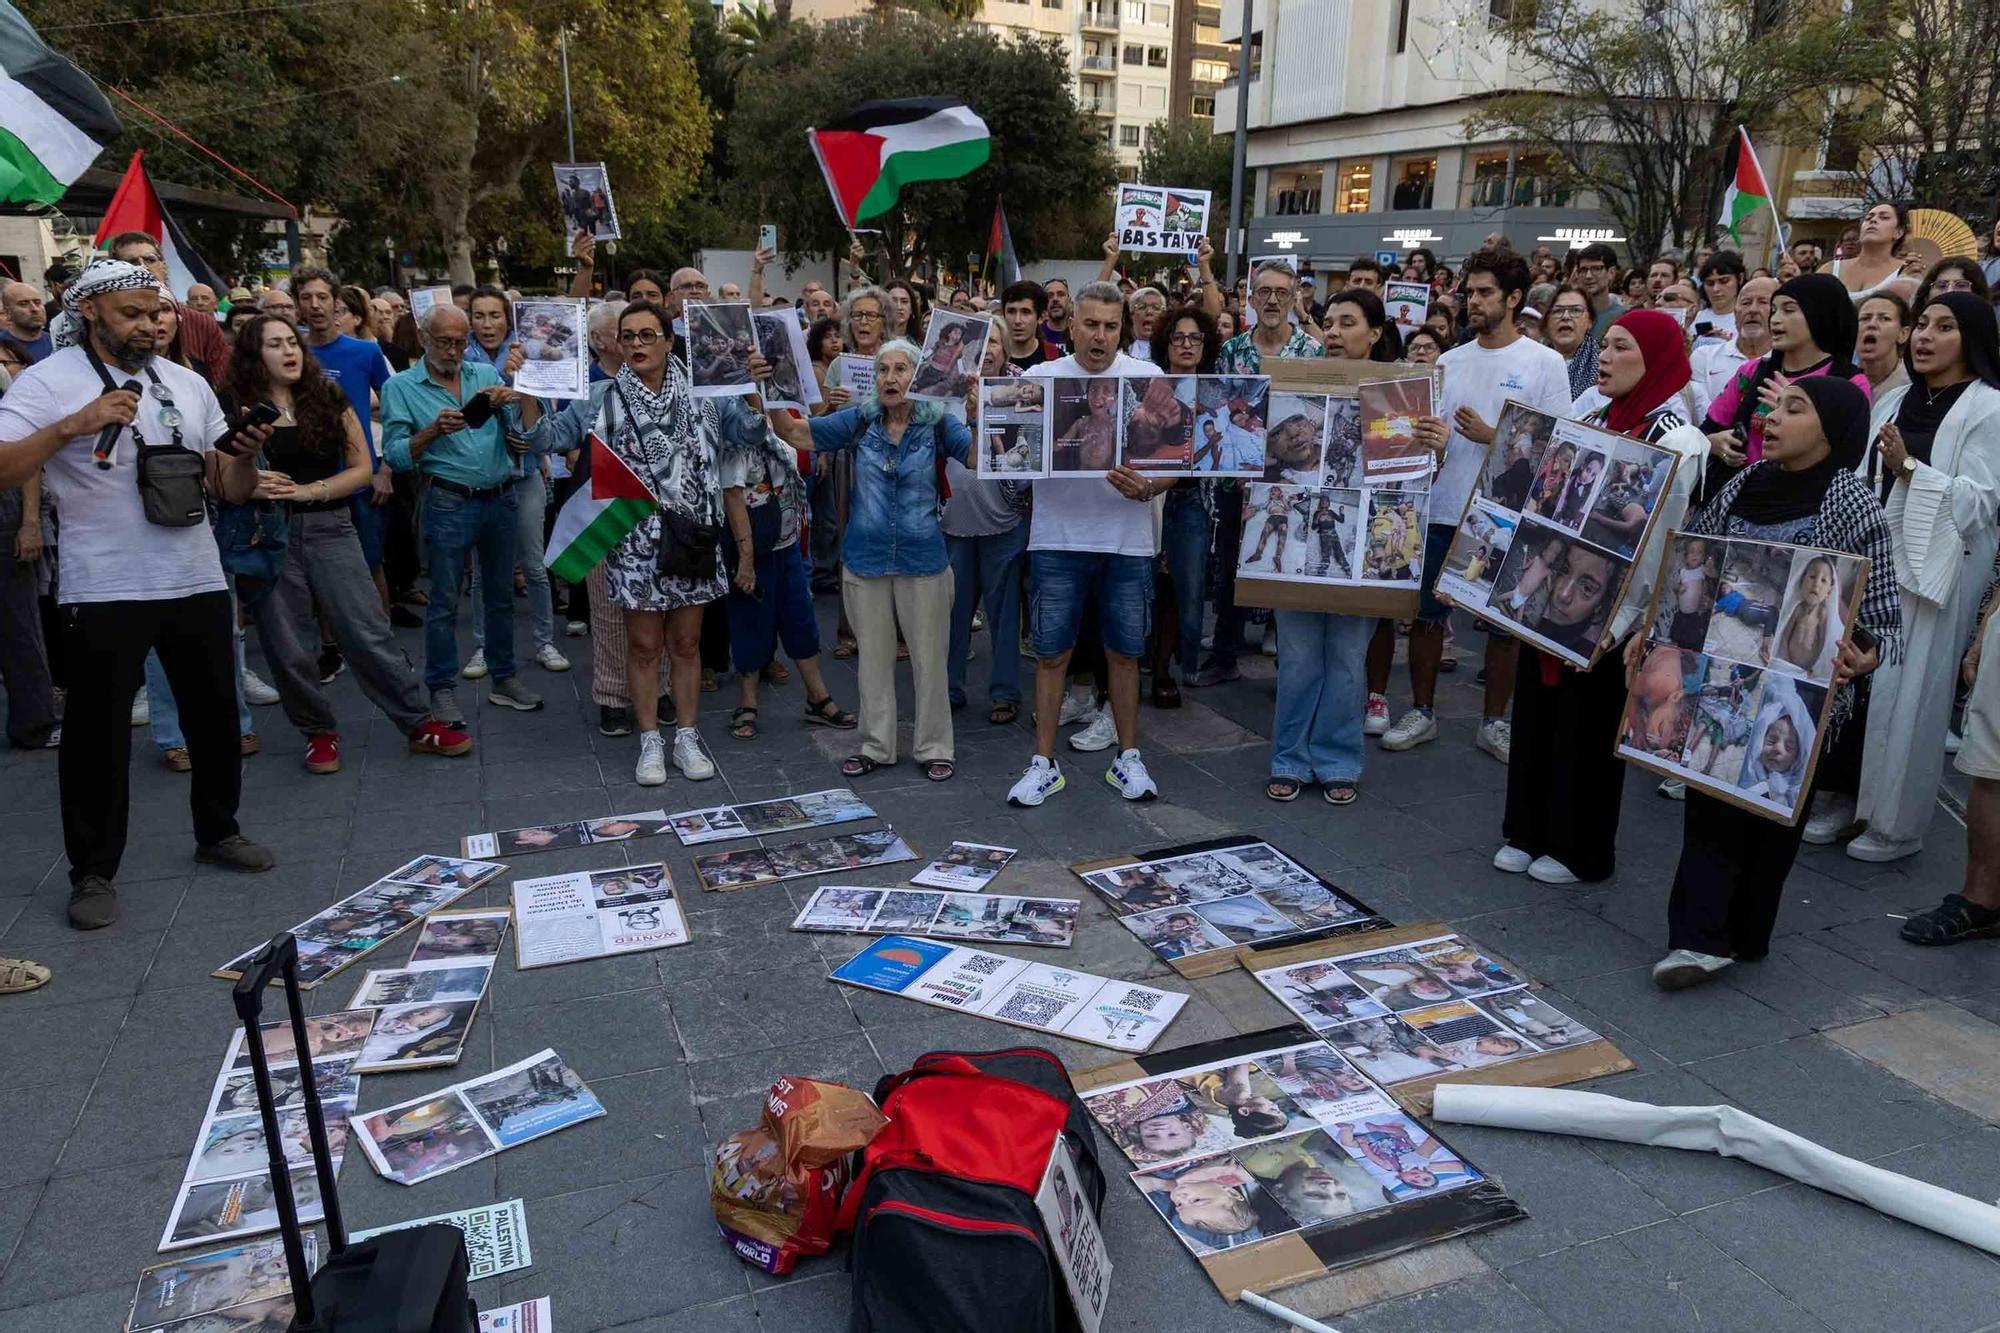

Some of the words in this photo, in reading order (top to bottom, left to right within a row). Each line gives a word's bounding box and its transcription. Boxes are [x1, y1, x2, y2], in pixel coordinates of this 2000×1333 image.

[1555, 228, 1614, 239] WEEKEND
[614, 930, 678, 944] WANTED
[921, 982, 971, 998] Movement
[942, 980, 966, 990] Gaza
[931, 992, 964, 1005] Global
[494, 1208, 514, 1269] PALESTINA
[1072, 1215, 1091, 1280] DEATH
[735, 1240, 771, 1264] WORLD
[1078, 1230, 1097, 1296] DEATH
[1091, 1268, 1103, 1317] IDF
